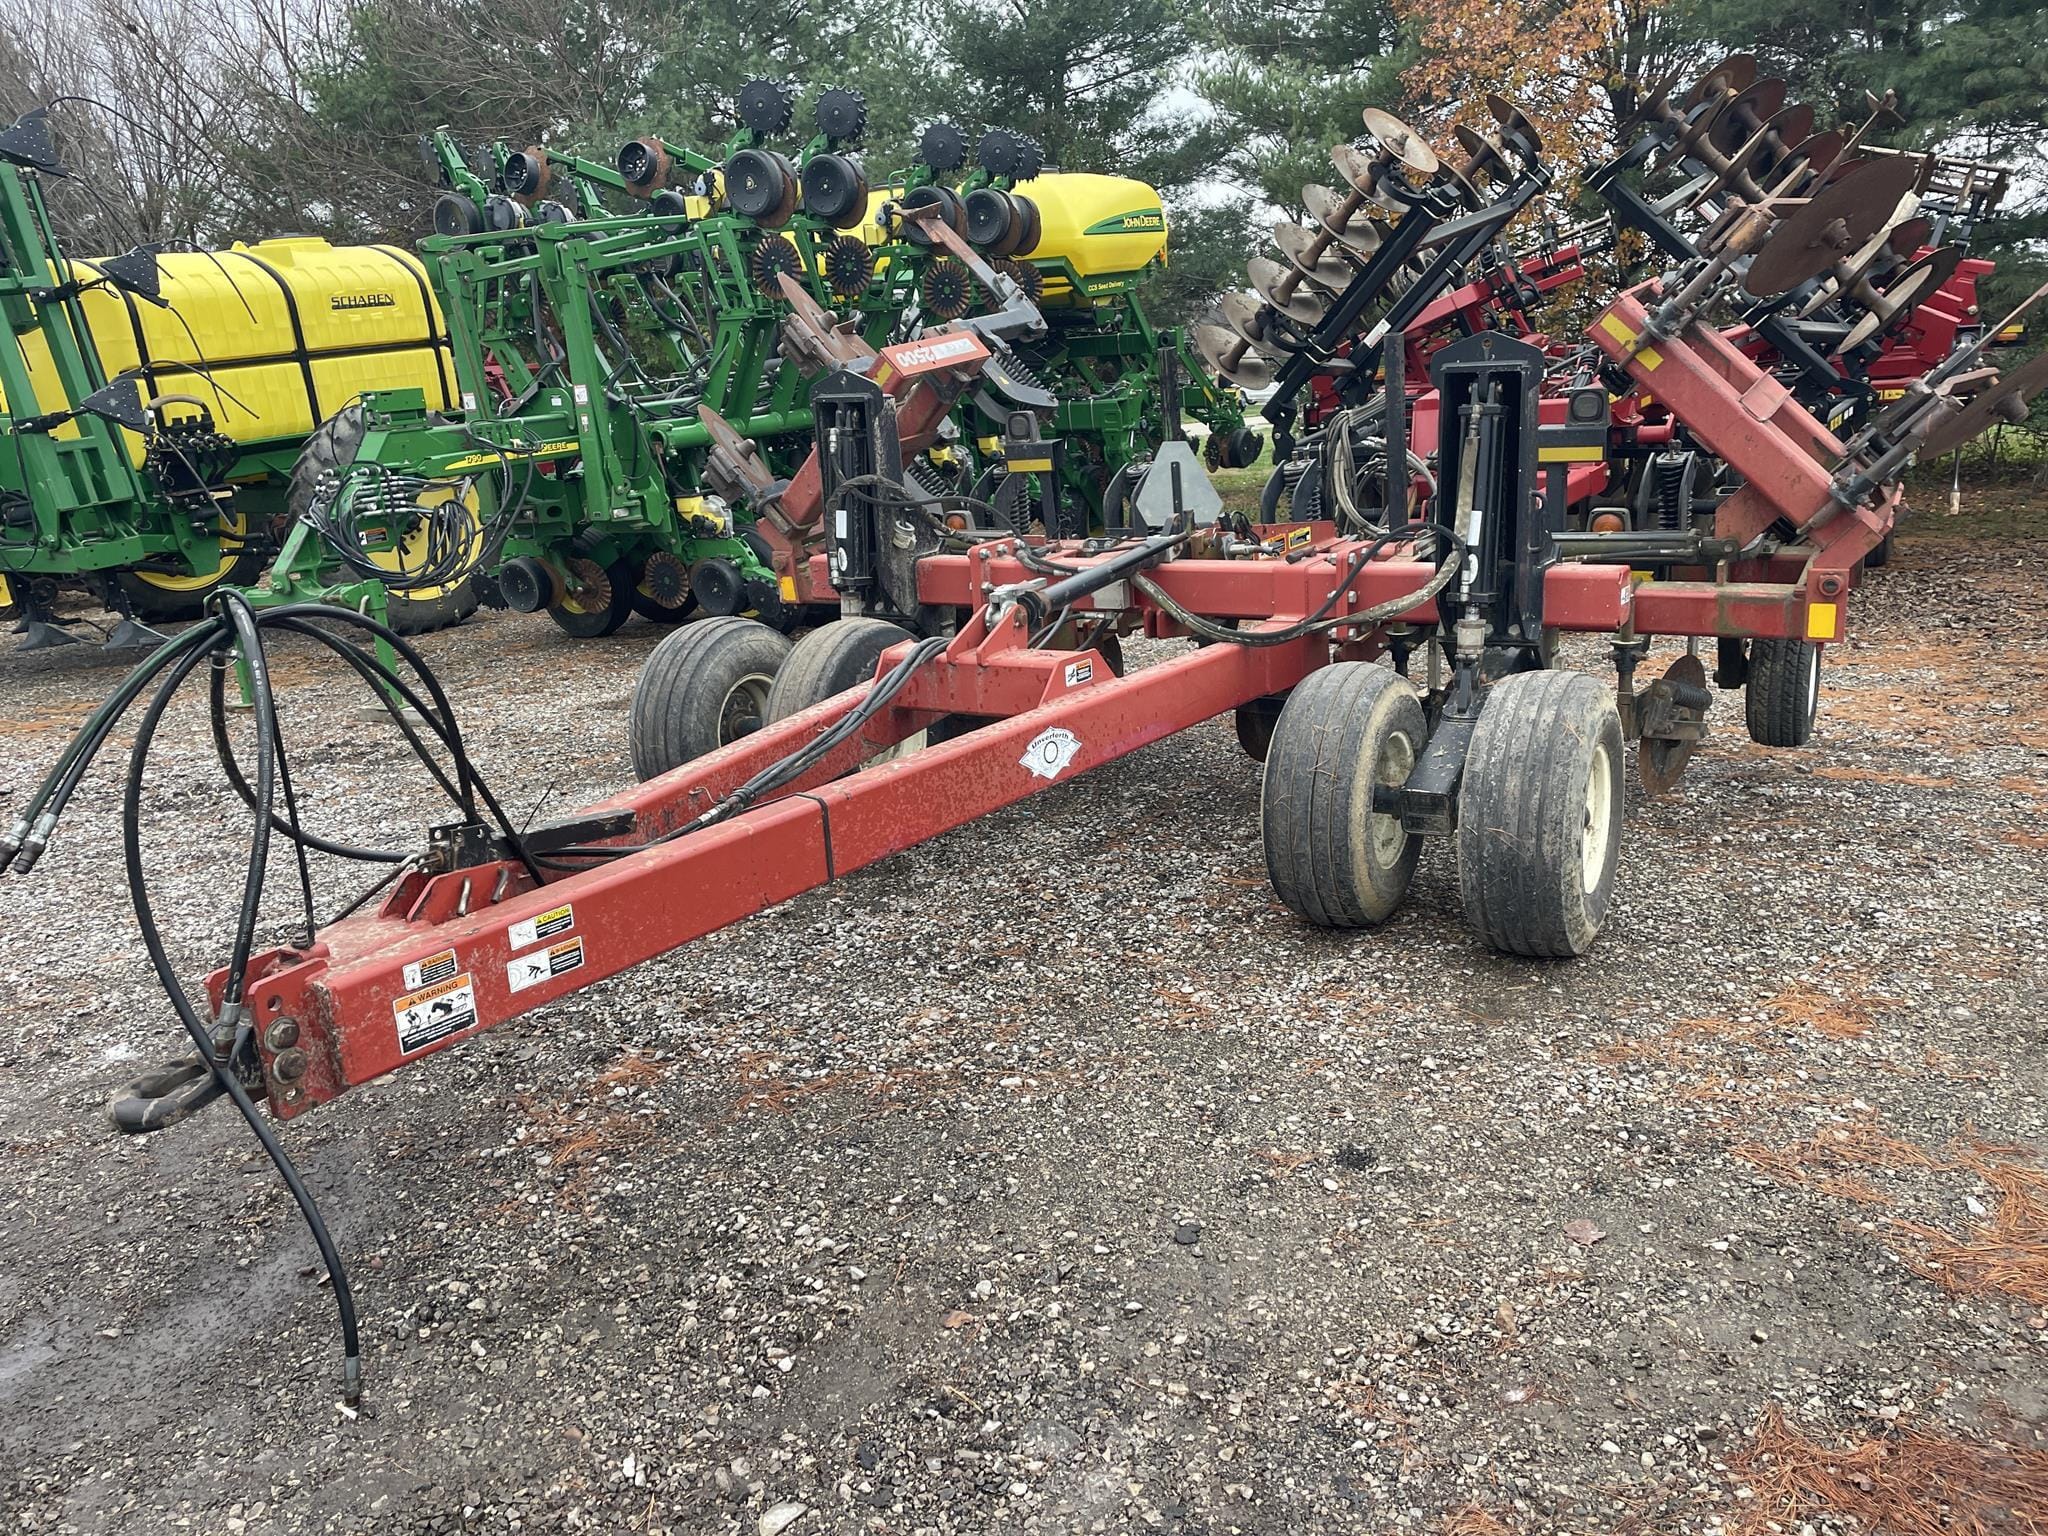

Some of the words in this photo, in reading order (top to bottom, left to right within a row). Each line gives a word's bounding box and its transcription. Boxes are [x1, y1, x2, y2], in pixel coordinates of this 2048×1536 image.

[1122, 216, 1140, 228] JOHN
[1140, 215, 1161, 227] DEERE
[1088, 283, 1098, 292] CCS
[1098, 282, 1109, 290] Seed
[1109, 281, 1125, 289] Delivery
[331, 293, 395, 306] SCHABEN
[895, 346, 935, 367] 2500
[465, 453, 484, 464] 1790
[1031, 732, 1069, 749] Unverferth
[542, 907, 570, 922] CAUTION
[417, 981, 458, 1002] WARNING
